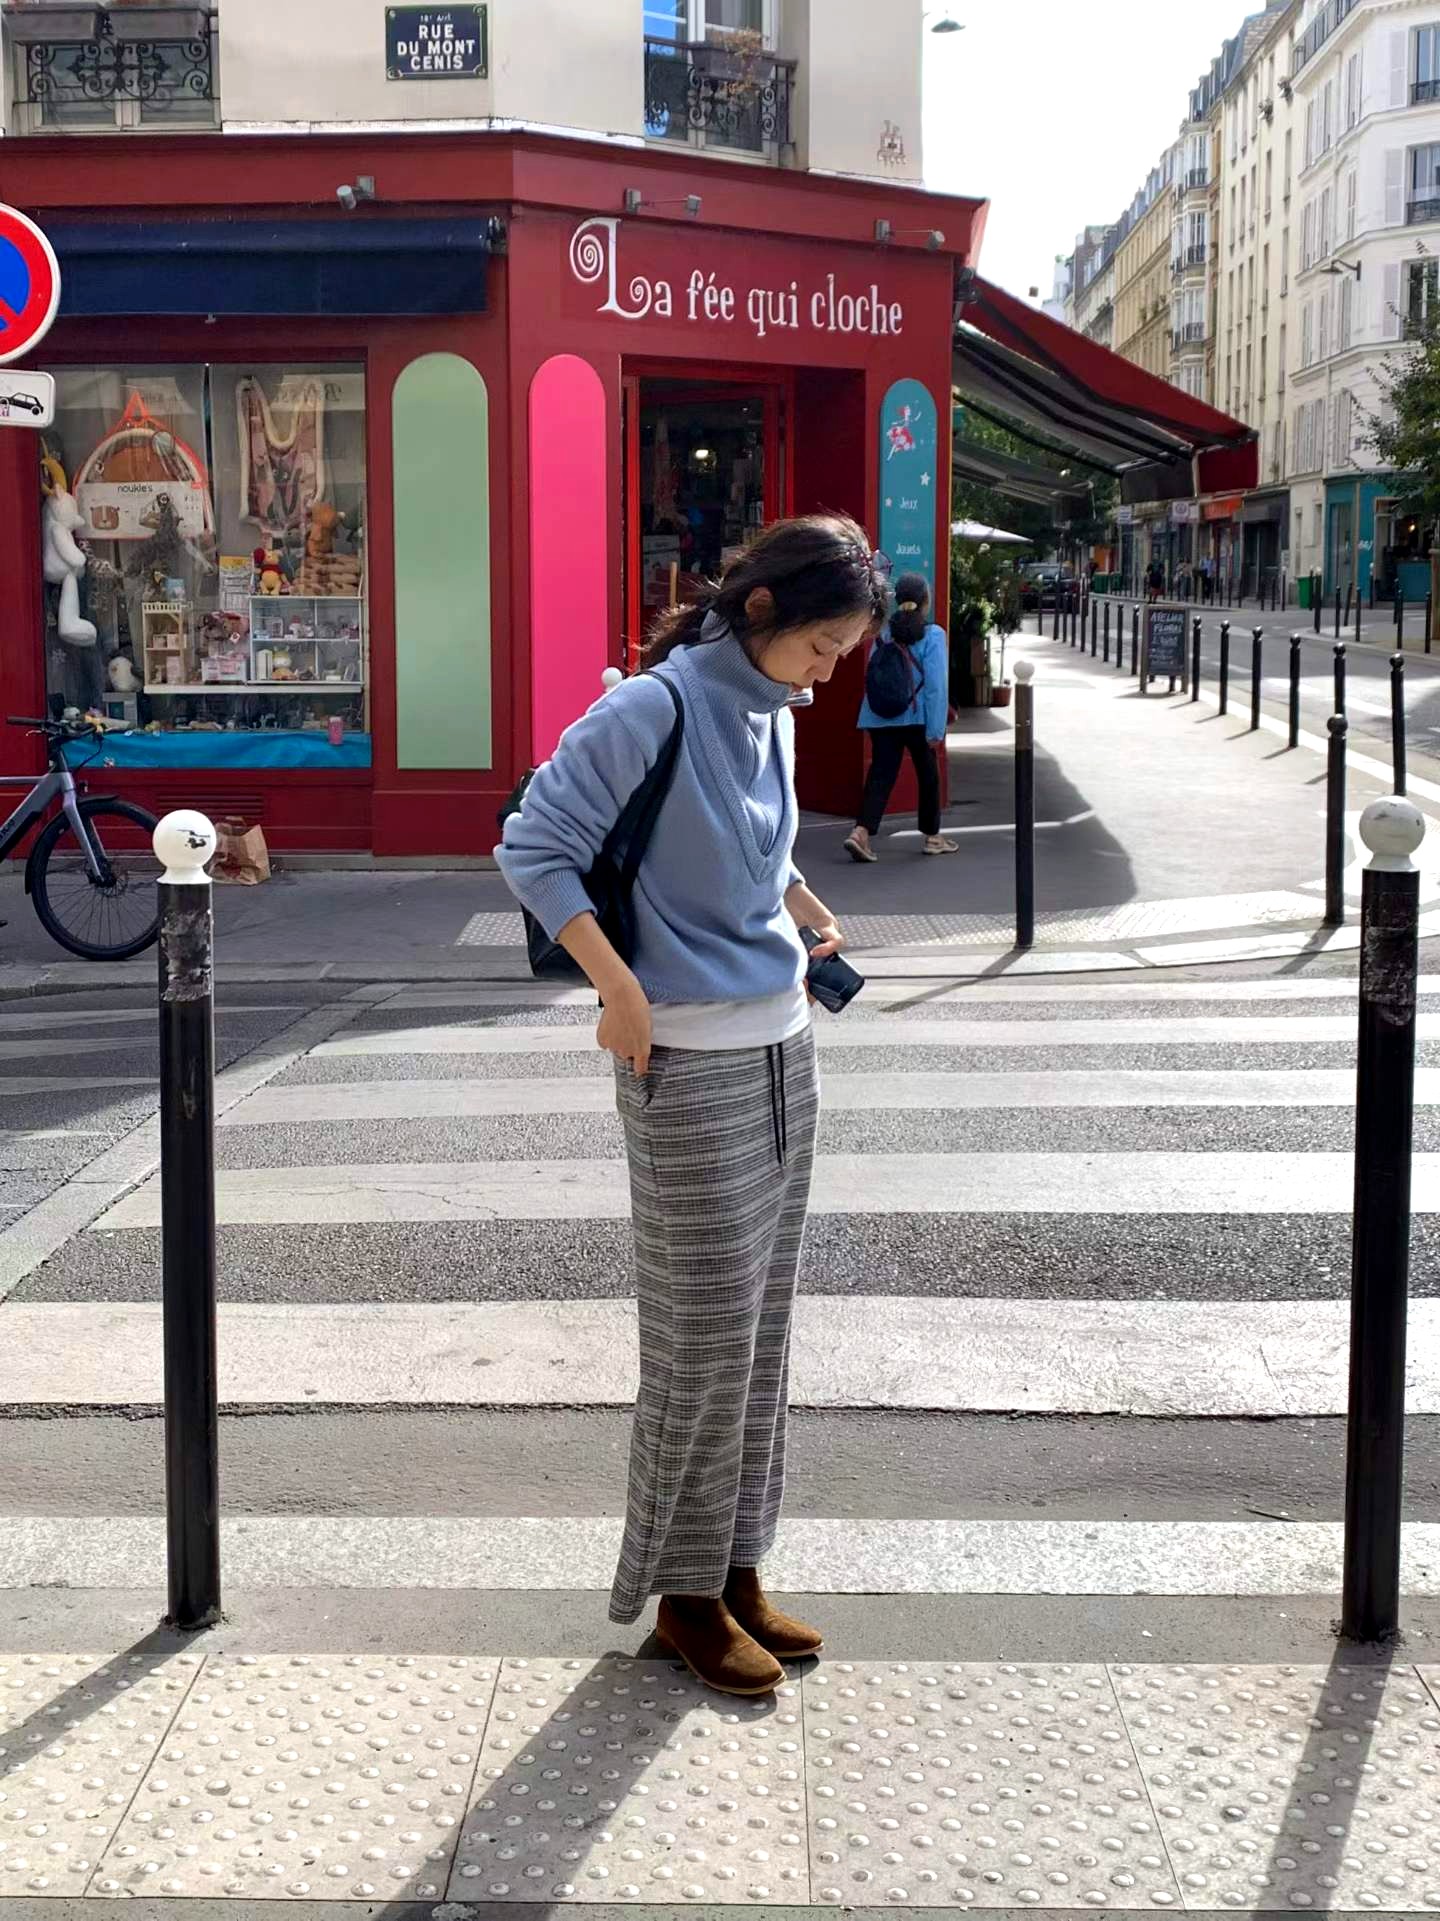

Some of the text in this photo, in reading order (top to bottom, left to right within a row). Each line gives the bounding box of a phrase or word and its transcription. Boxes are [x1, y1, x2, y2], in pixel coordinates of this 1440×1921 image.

[419, 24, 454, 39] RUE
[397, 40, 475, 56] DU MONT
[410, 55, 463, 71] CENIS
[569, 216, 903, 337] La fée qui cloche
